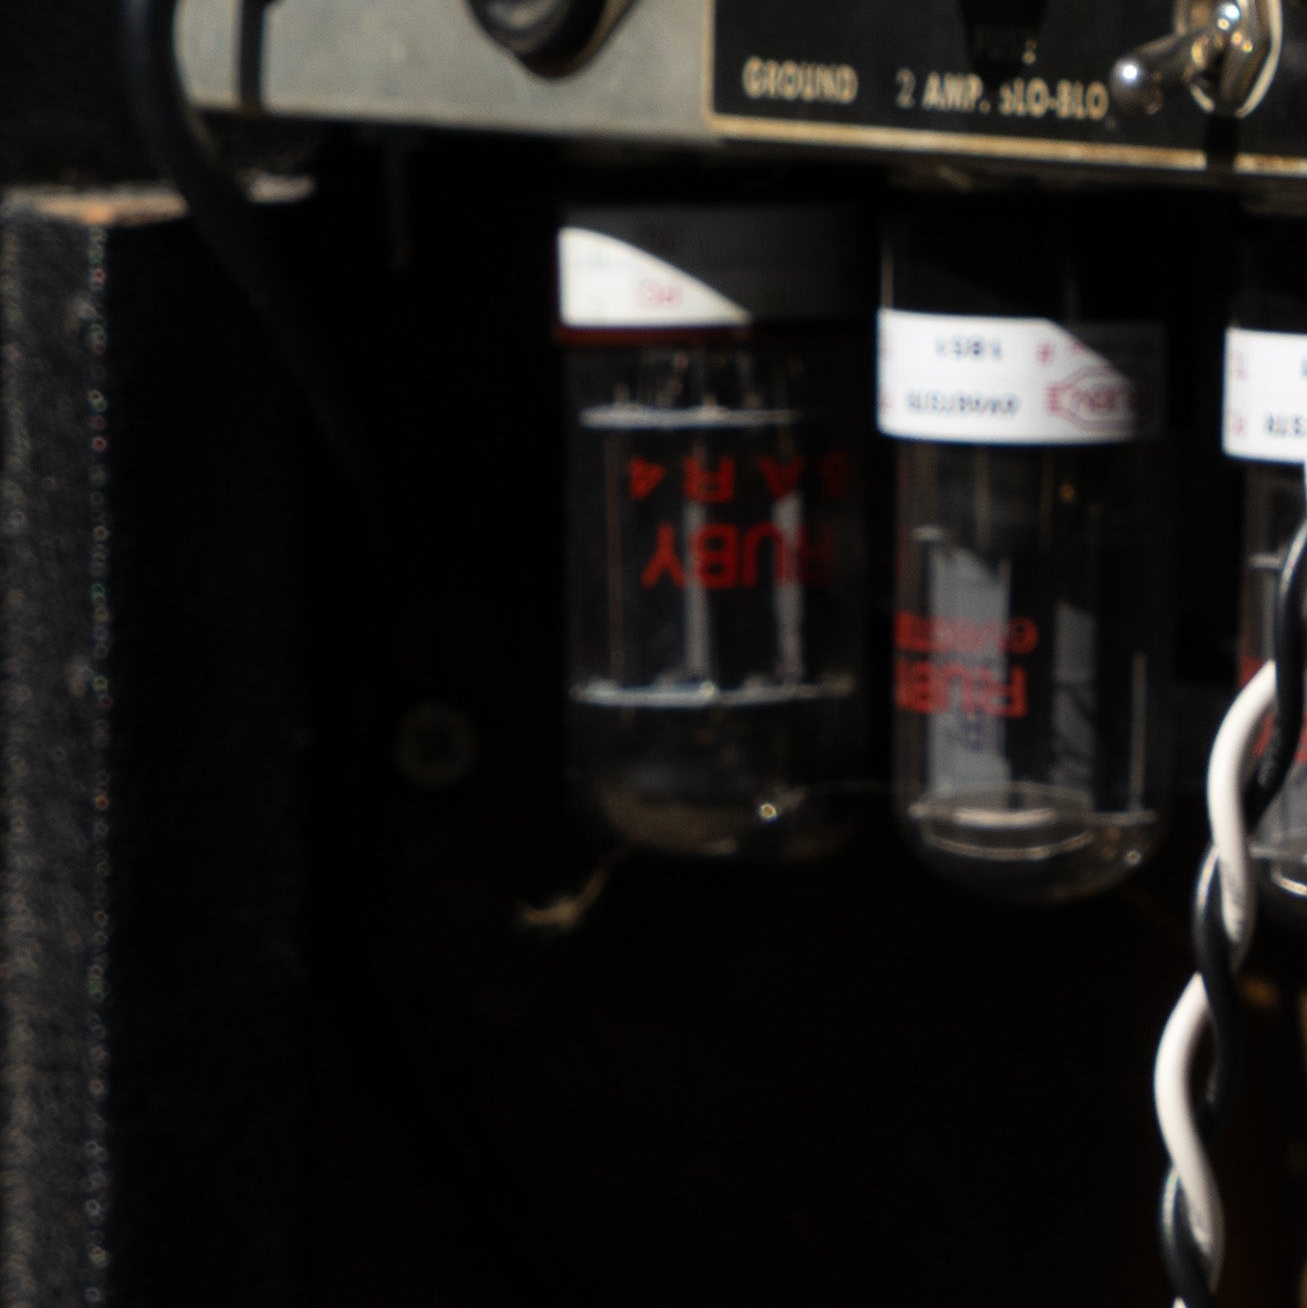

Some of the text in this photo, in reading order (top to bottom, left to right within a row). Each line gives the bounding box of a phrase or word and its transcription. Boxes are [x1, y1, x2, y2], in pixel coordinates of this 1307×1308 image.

[741, 54, 859, 106] GROUND
[895, 67, 917, 110] 2
[921, 70, 992, 115] AMP.
[639, 520, 835, 592] RUBY
